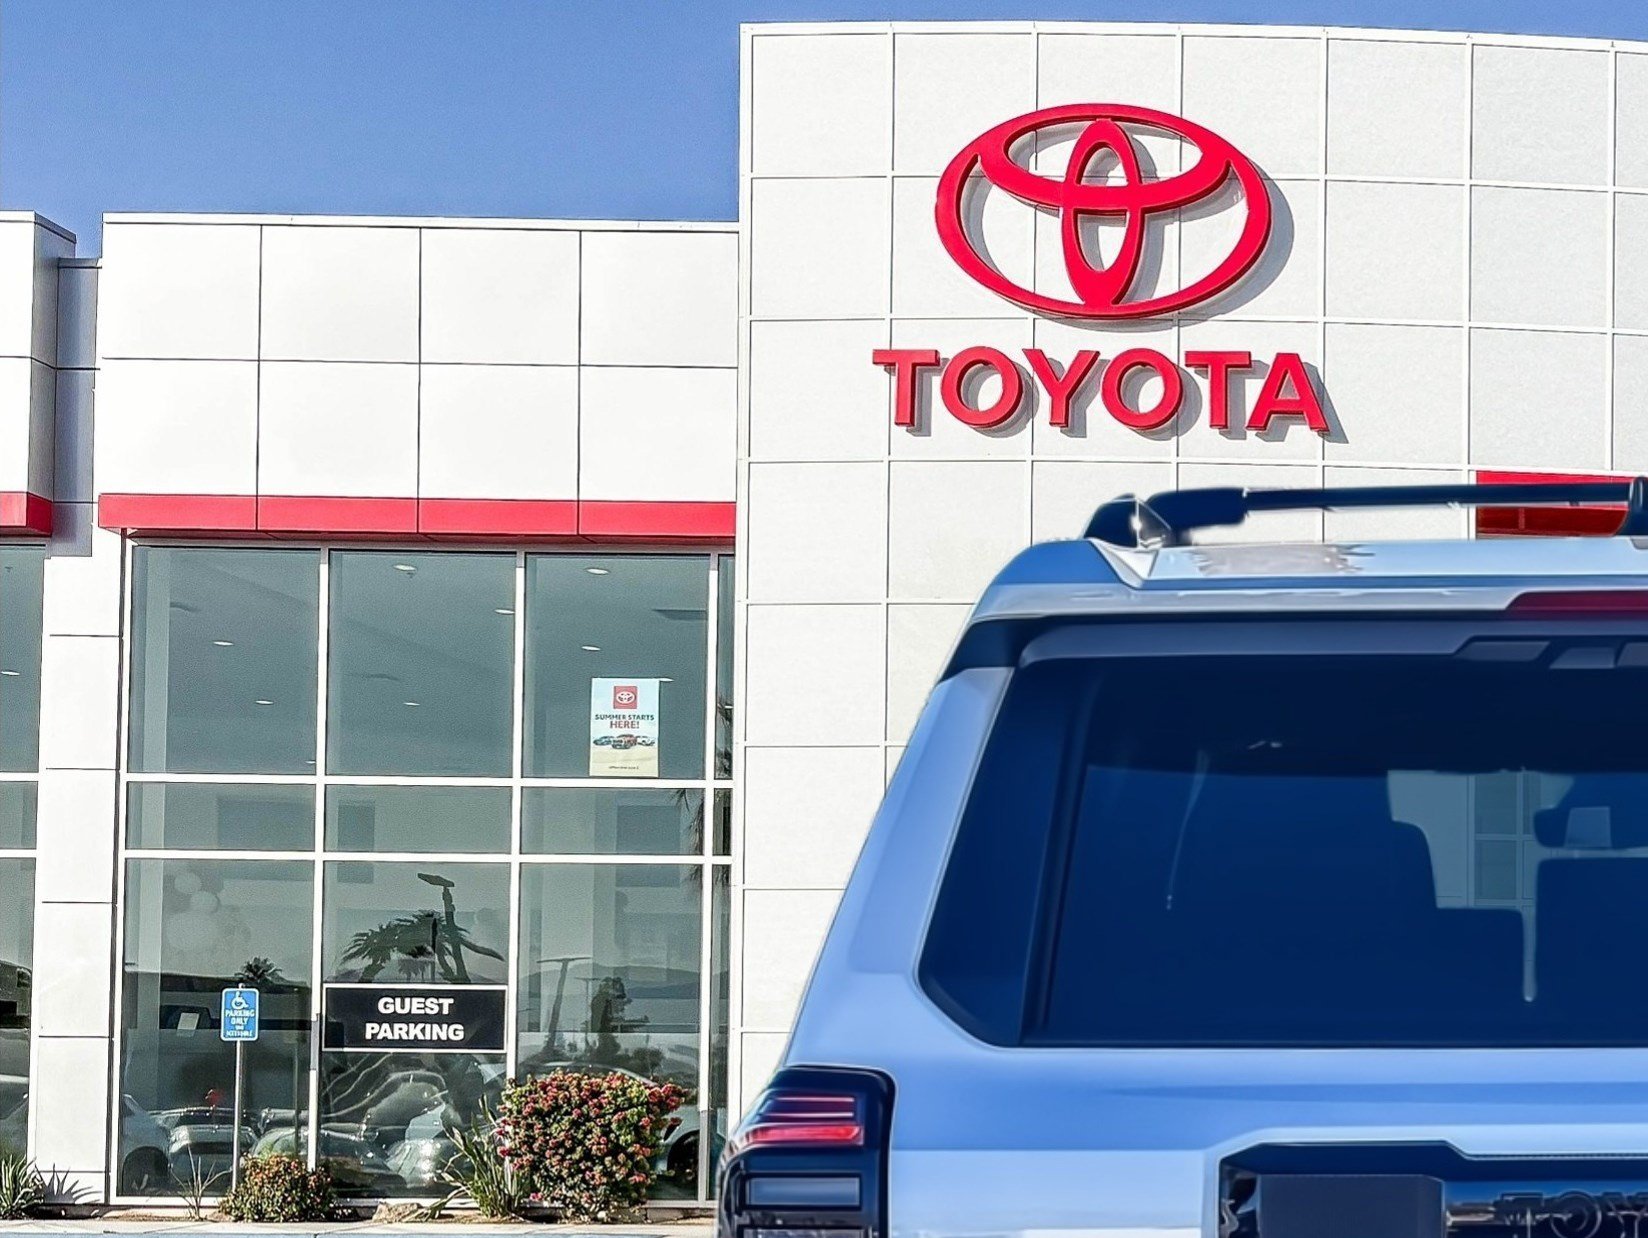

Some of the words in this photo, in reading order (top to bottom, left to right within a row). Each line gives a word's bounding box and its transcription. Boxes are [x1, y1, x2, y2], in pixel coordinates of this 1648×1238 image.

[872, 346, 1331, 434] TOYOTA
[609, 720, 640, 729] HERE!
[377, 996, 454, 1015] GUEST
[364, 1022, 465, 1041] PARKING
